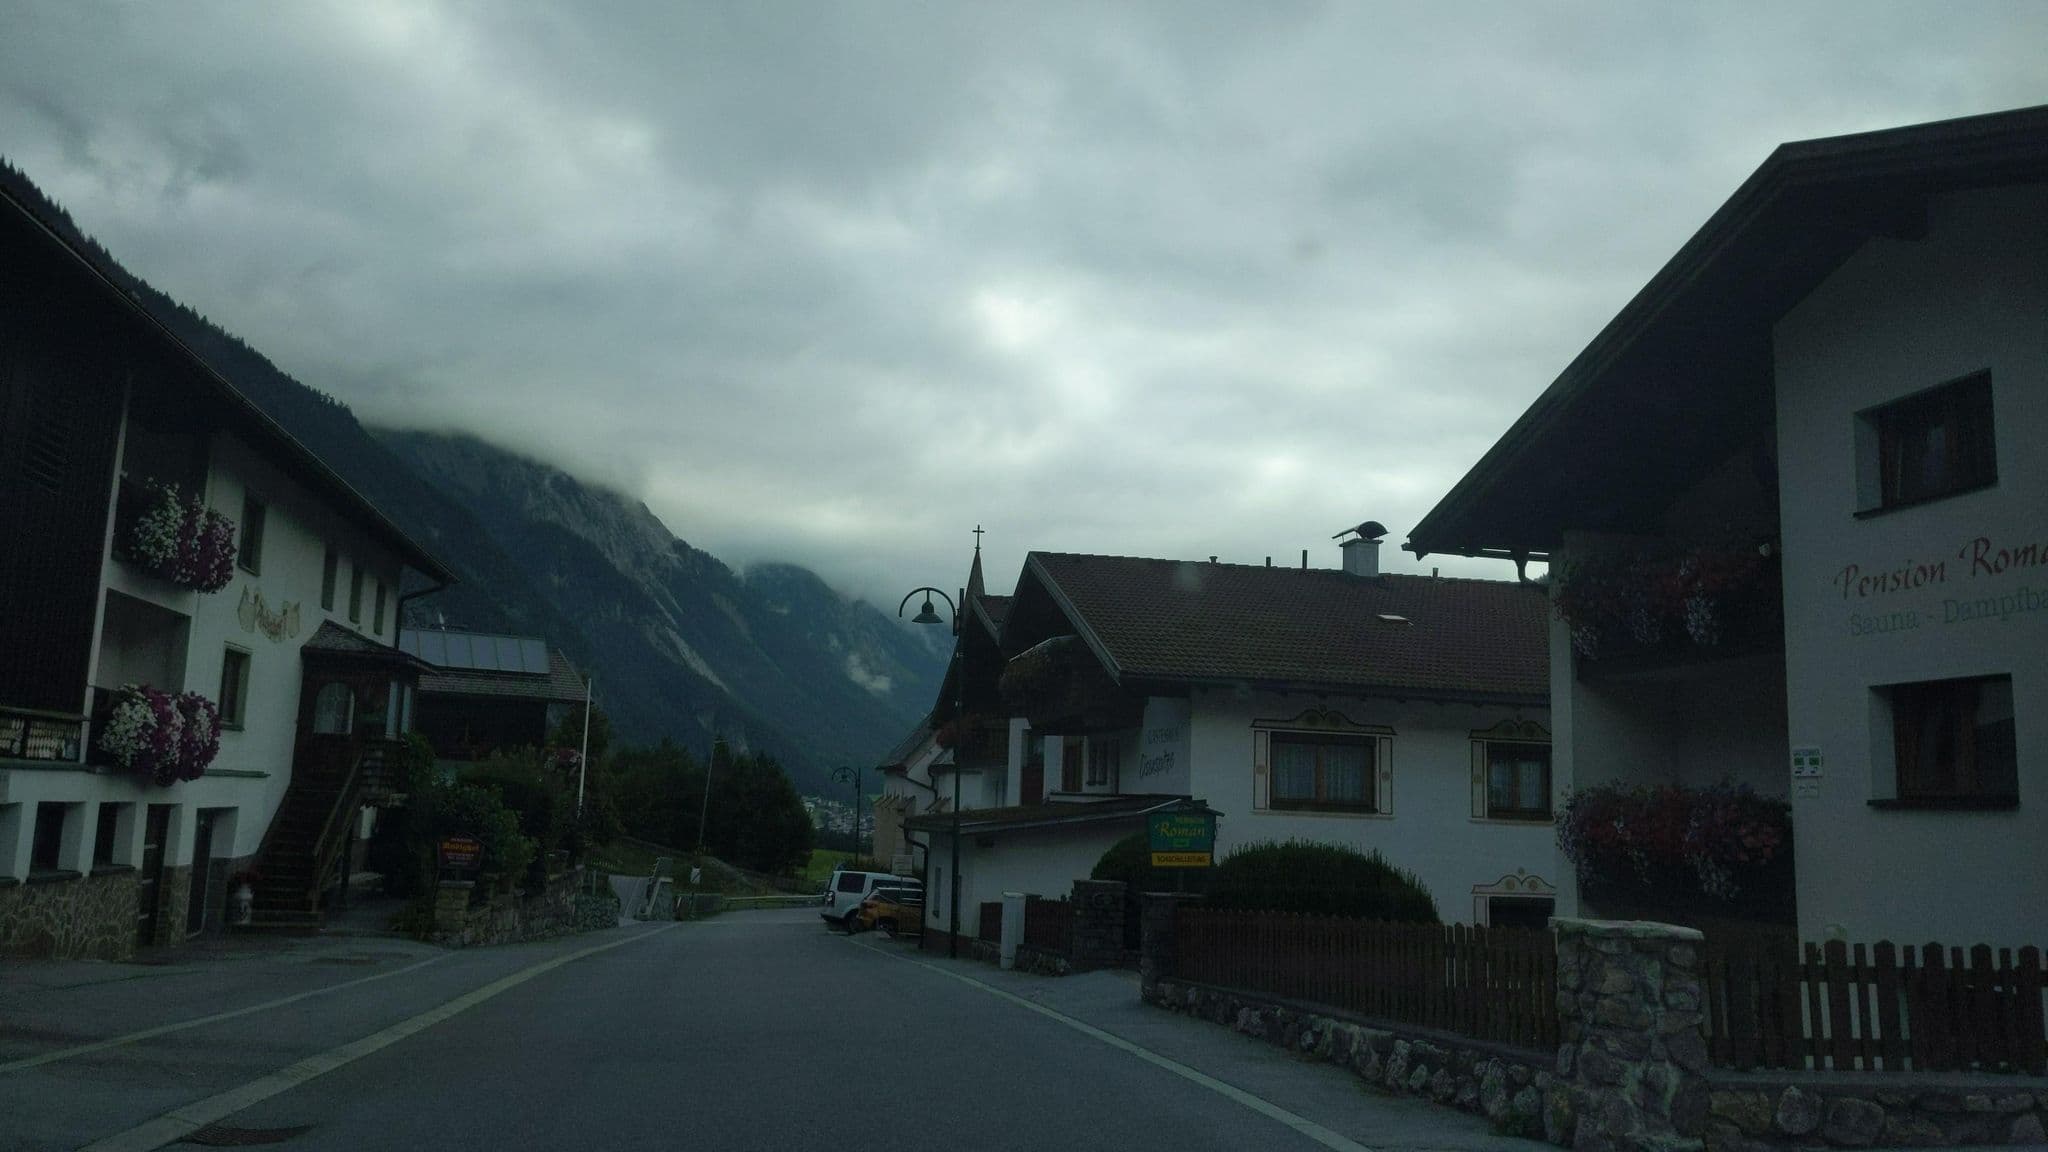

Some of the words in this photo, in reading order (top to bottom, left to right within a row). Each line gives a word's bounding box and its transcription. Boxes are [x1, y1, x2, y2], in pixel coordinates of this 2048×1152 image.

[1834, 559, 1946, 600] Pension
[1850, 608, 1920, 636] Sauna
[1155, 822, 1205, 838] Roman
